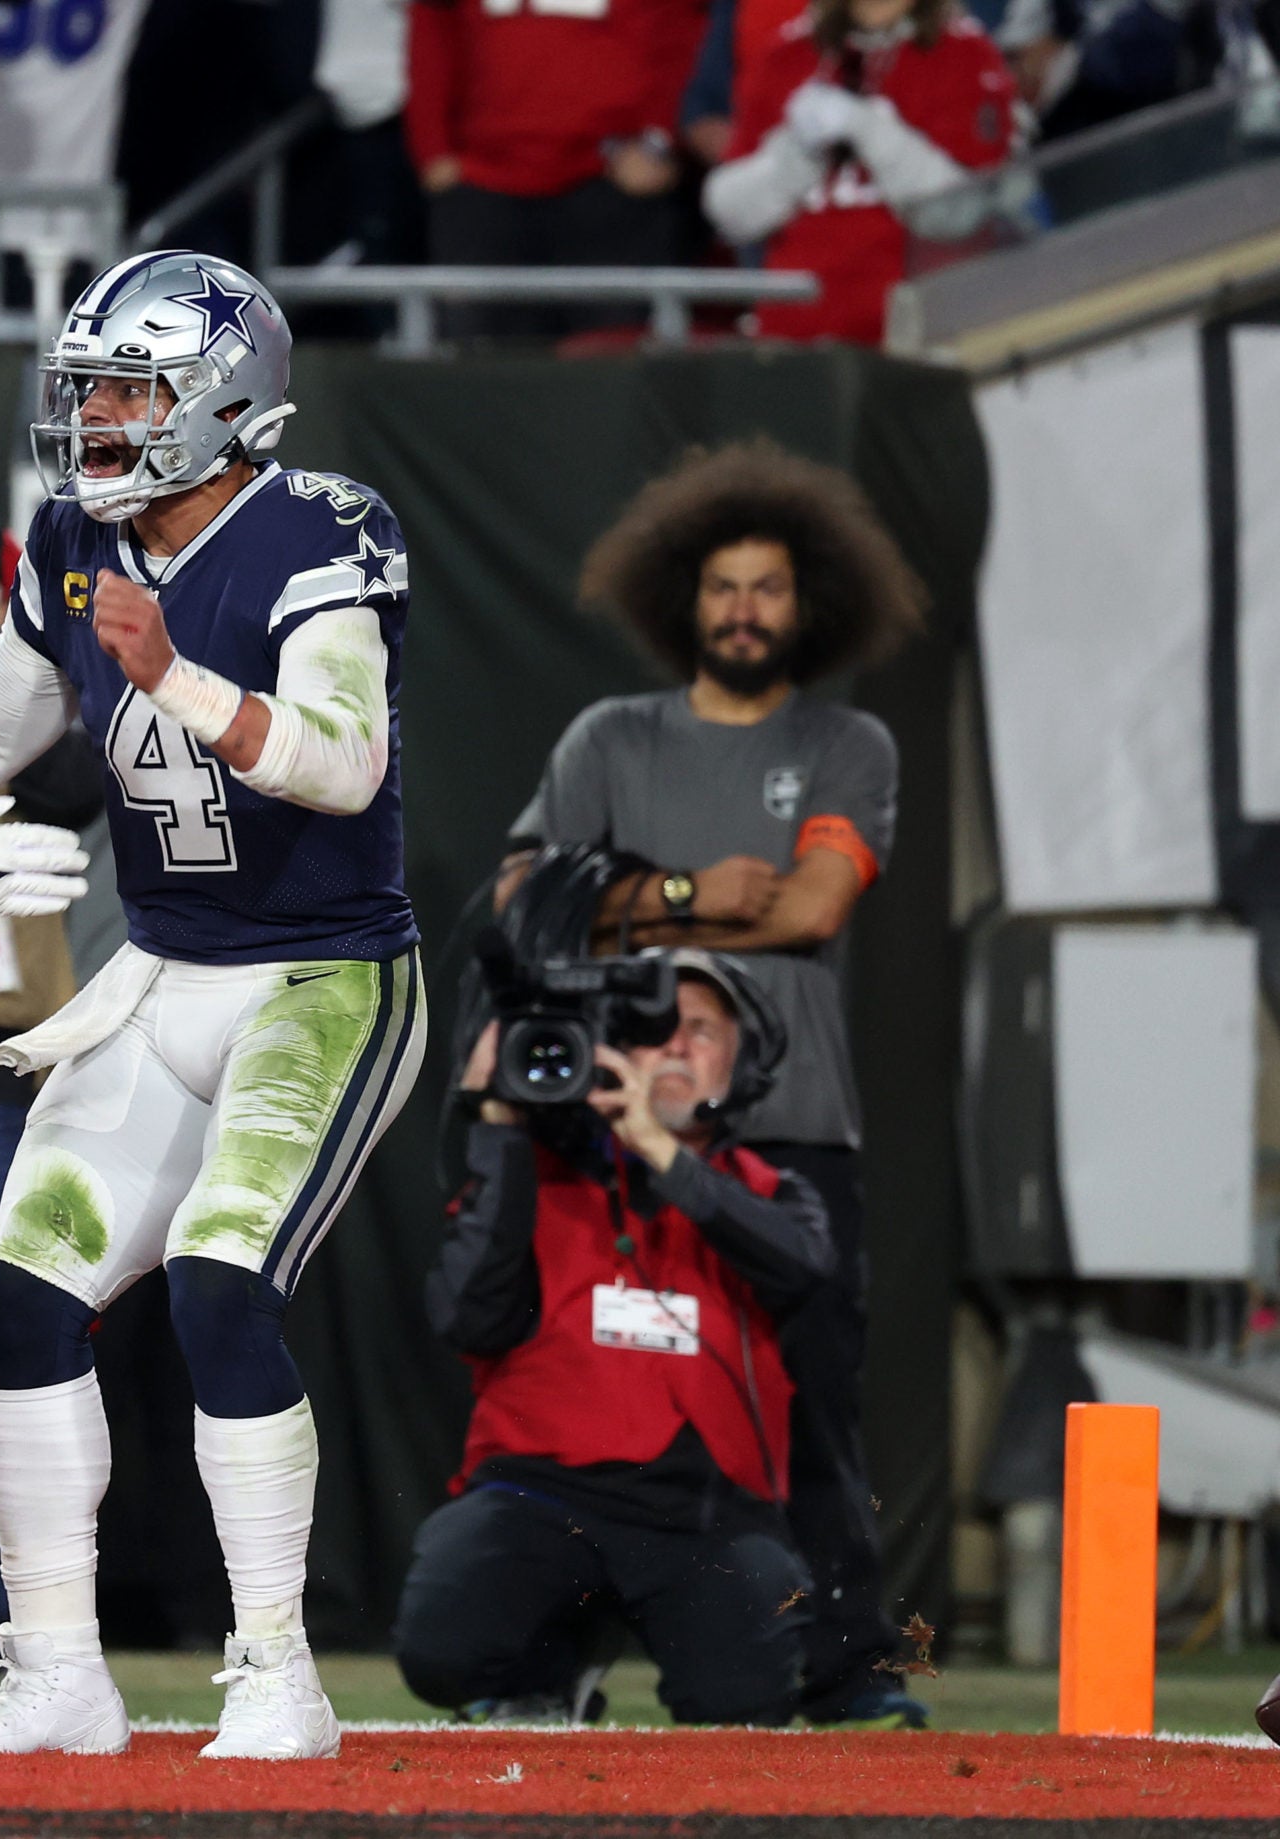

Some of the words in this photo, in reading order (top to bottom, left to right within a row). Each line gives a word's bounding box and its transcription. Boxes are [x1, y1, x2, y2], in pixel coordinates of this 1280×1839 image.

[286, 471, 368, 512] 4
[63, 571, 89, 610] C
[104, 681, 238, 873] 4
